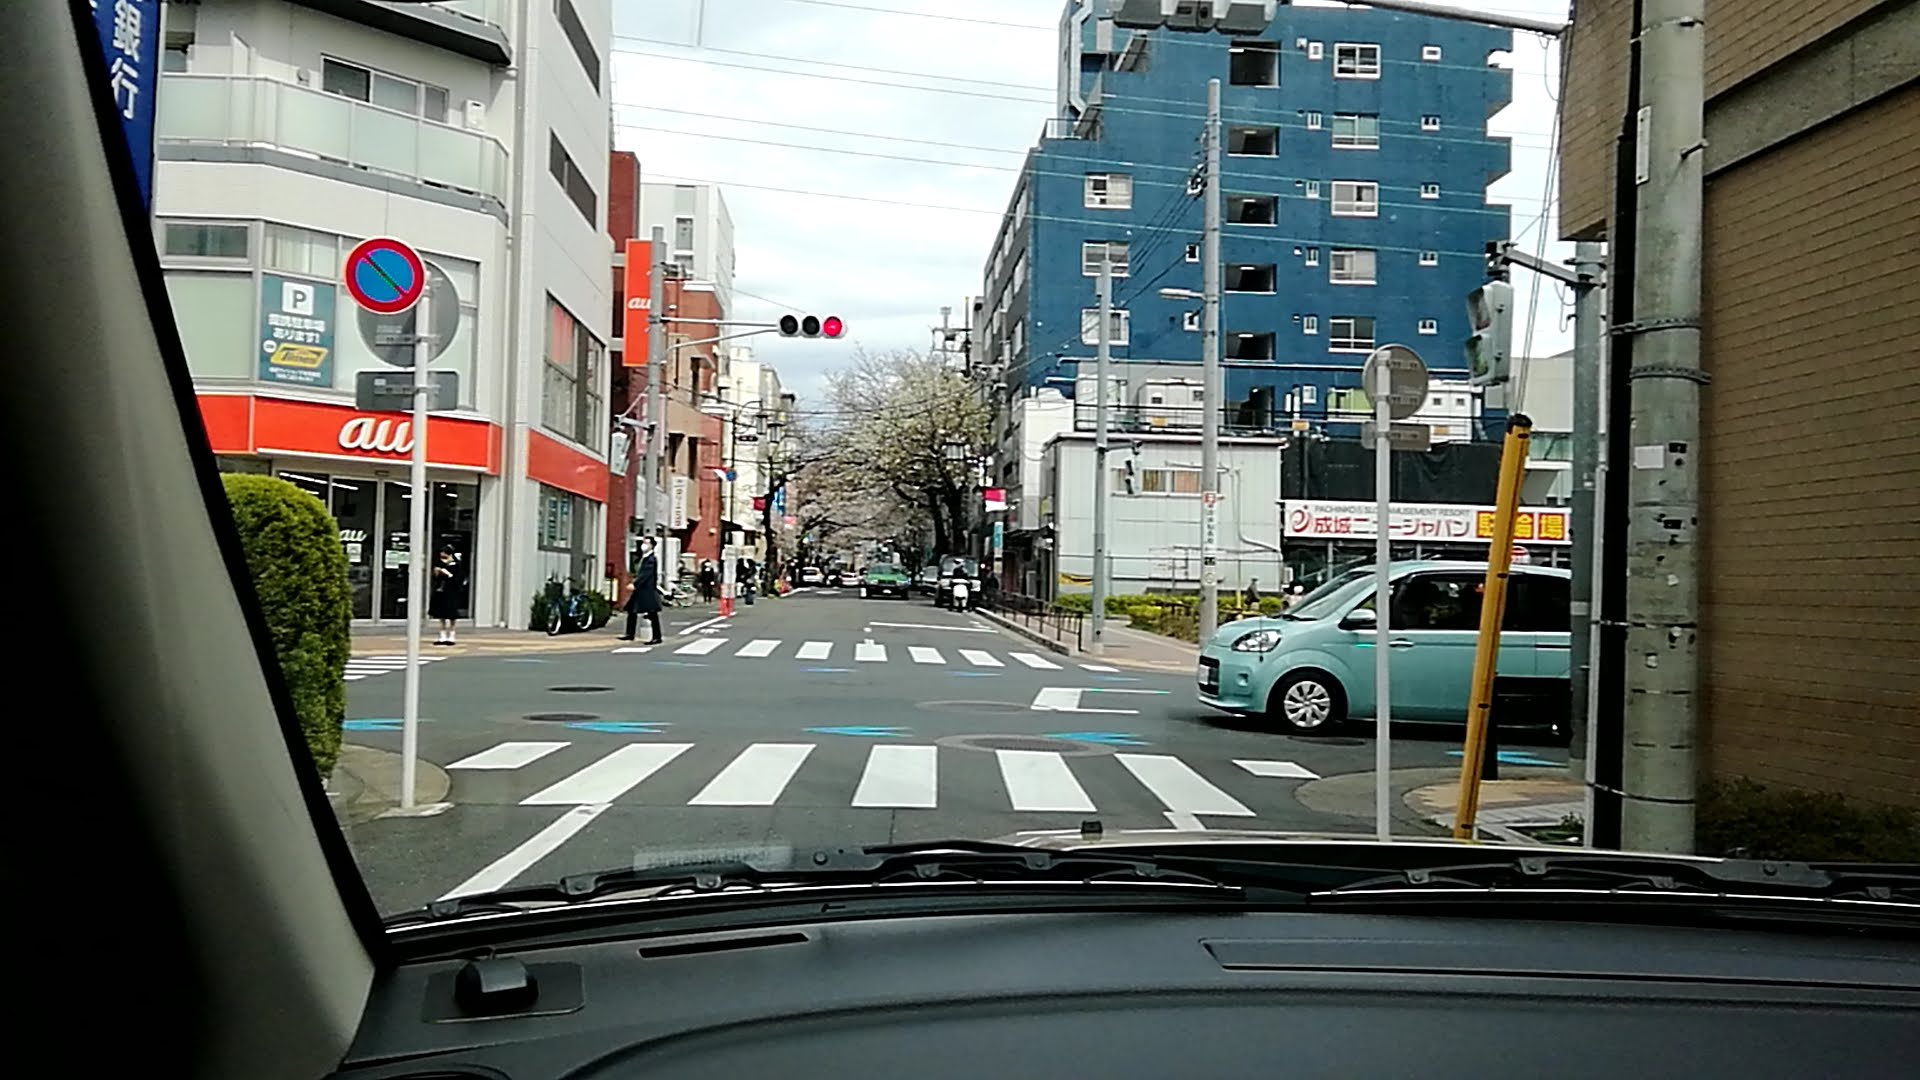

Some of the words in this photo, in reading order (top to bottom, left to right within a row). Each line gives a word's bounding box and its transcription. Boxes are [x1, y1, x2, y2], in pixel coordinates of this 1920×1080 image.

[111, 0, 141, 119] 銀行
[292, 290, 307, 309] P
[627, 297, 652, 310] au
[338, 417, 415, 453] au
[339, 528, 367, 543] au
